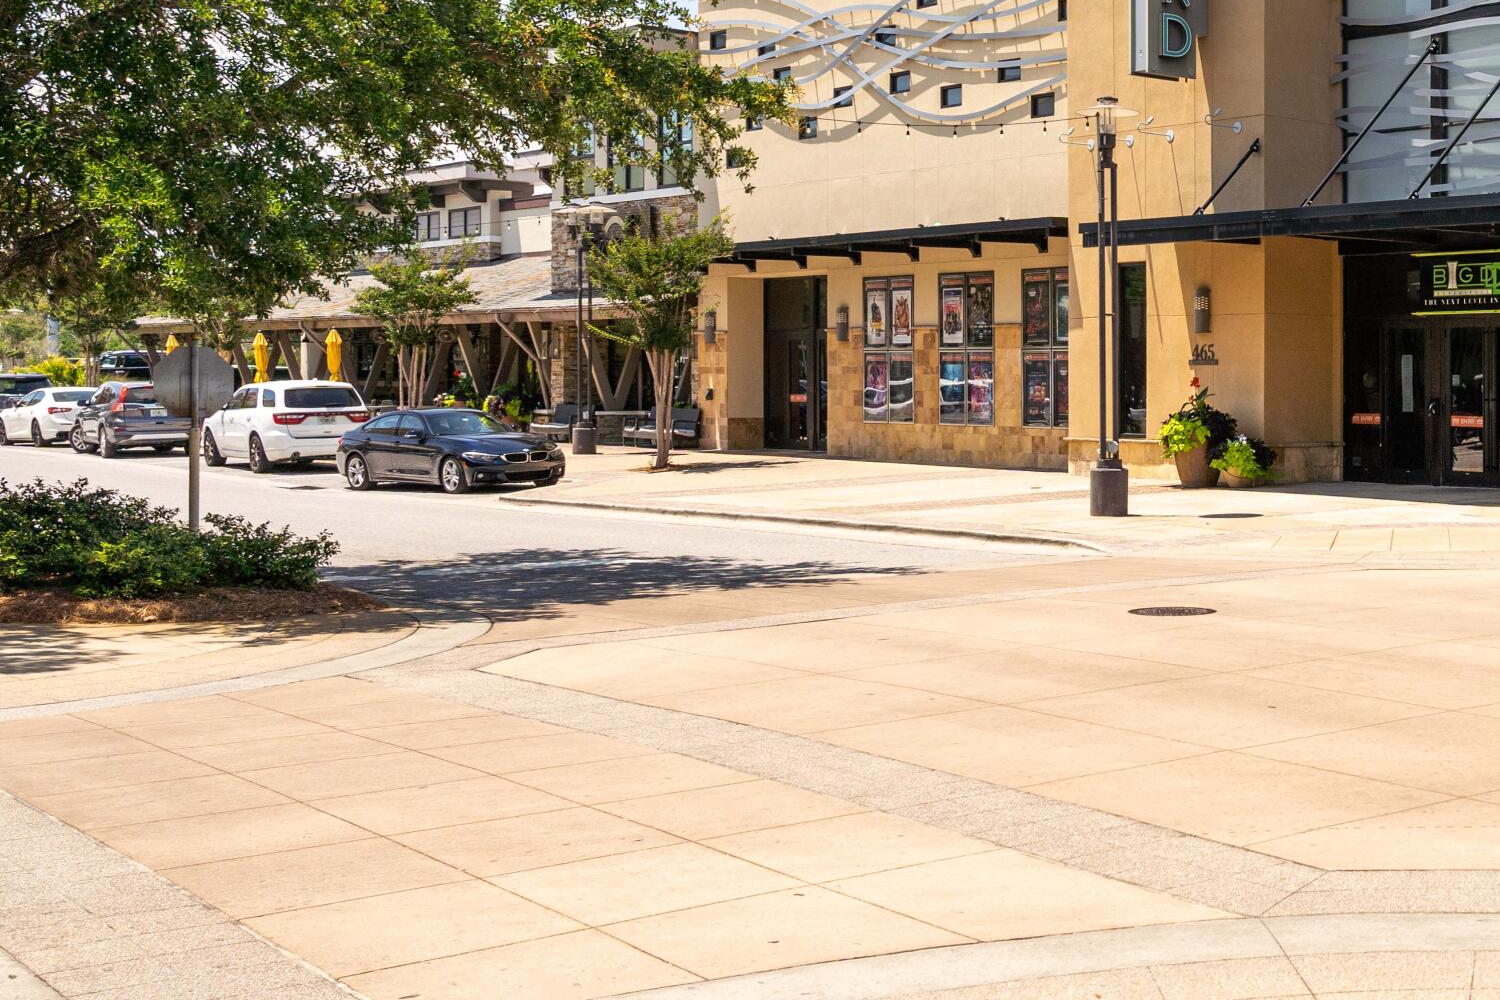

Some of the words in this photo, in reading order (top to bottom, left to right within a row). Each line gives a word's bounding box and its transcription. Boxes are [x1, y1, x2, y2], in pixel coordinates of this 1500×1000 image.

[1433, 261, 1474, 289] BIG
[1441, 298, 1460, 306] NEXT
[1463, 297, 1487, 305] LEVEL
[1192, 343, 1216, 361] 465
